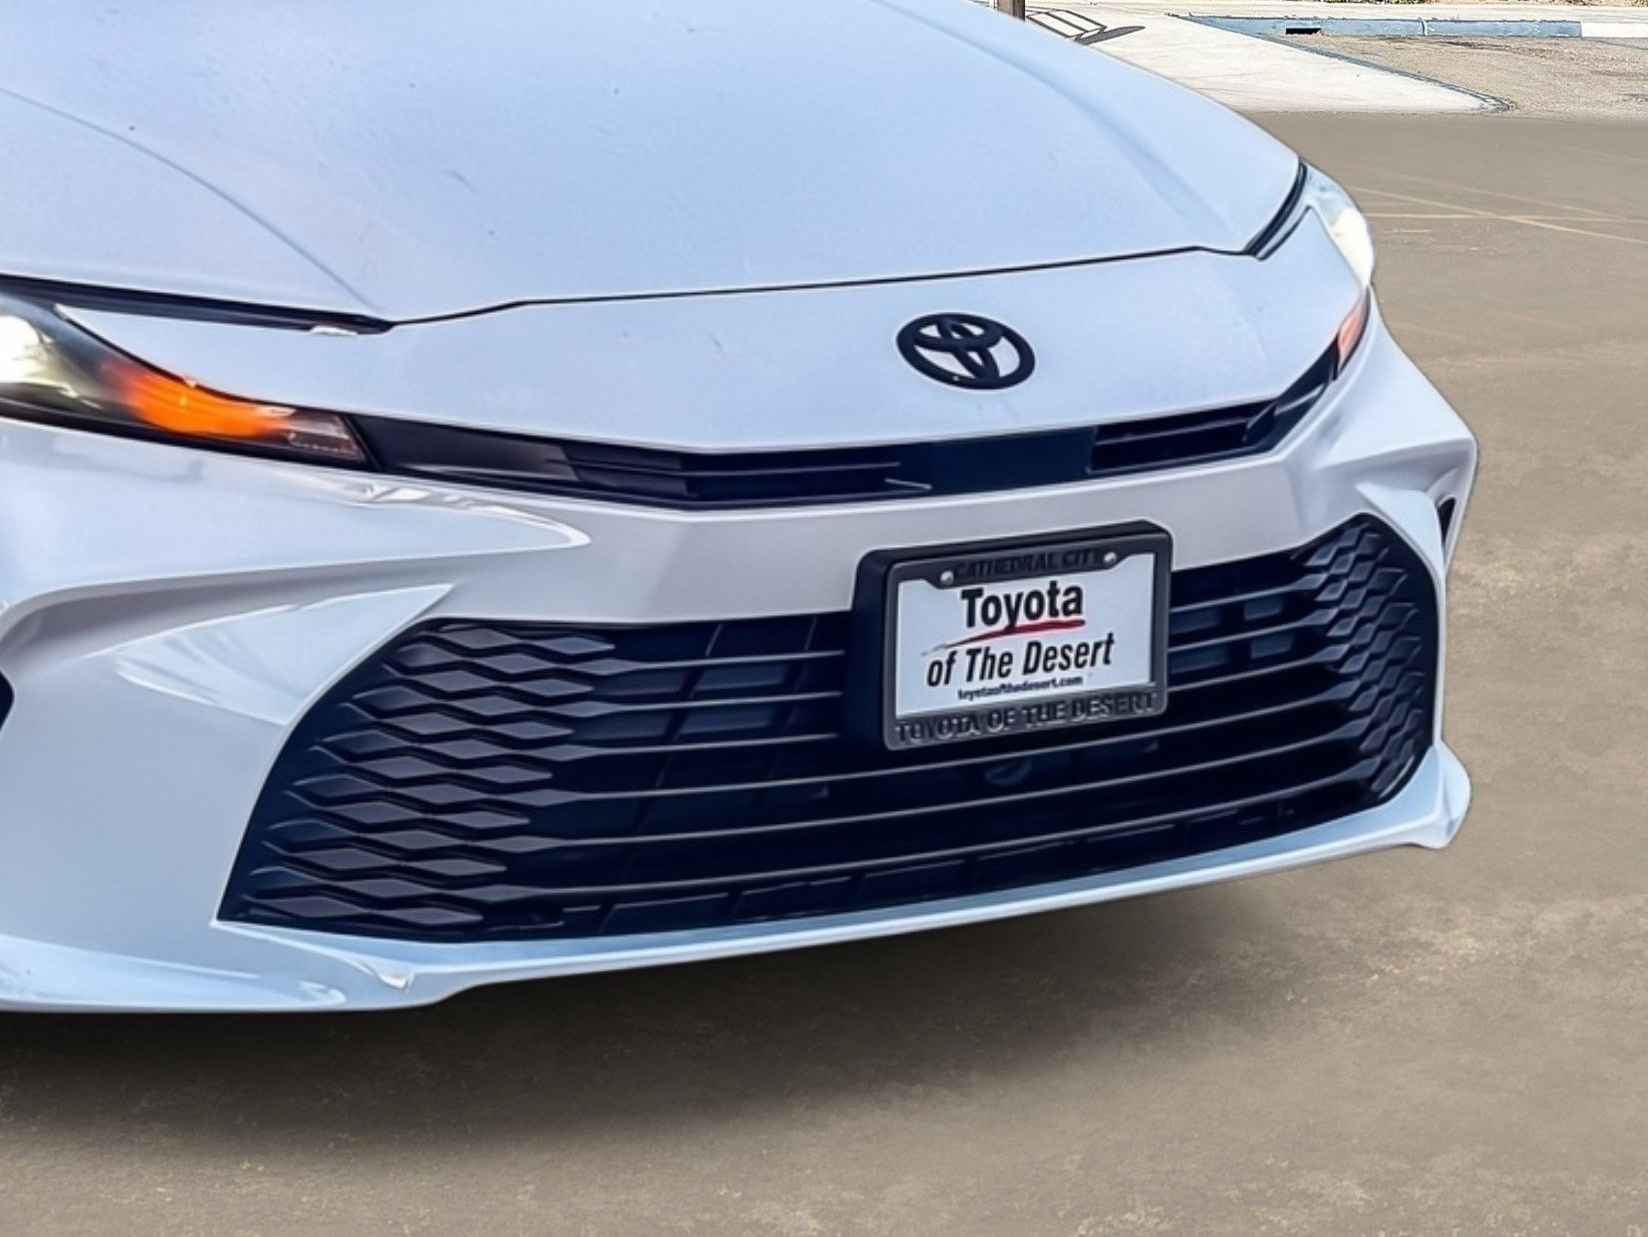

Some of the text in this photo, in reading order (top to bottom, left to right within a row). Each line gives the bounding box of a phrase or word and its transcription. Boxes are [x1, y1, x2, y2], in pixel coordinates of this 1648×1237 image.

[960, 580, 1085, 631] Toyota
[926, 632, 1115, 687] of The Desert
[895, 715, 981, 743] TOYOTA
[986, 707, 1017, 733] OF
[1021, 700, 1067, 728] THE
